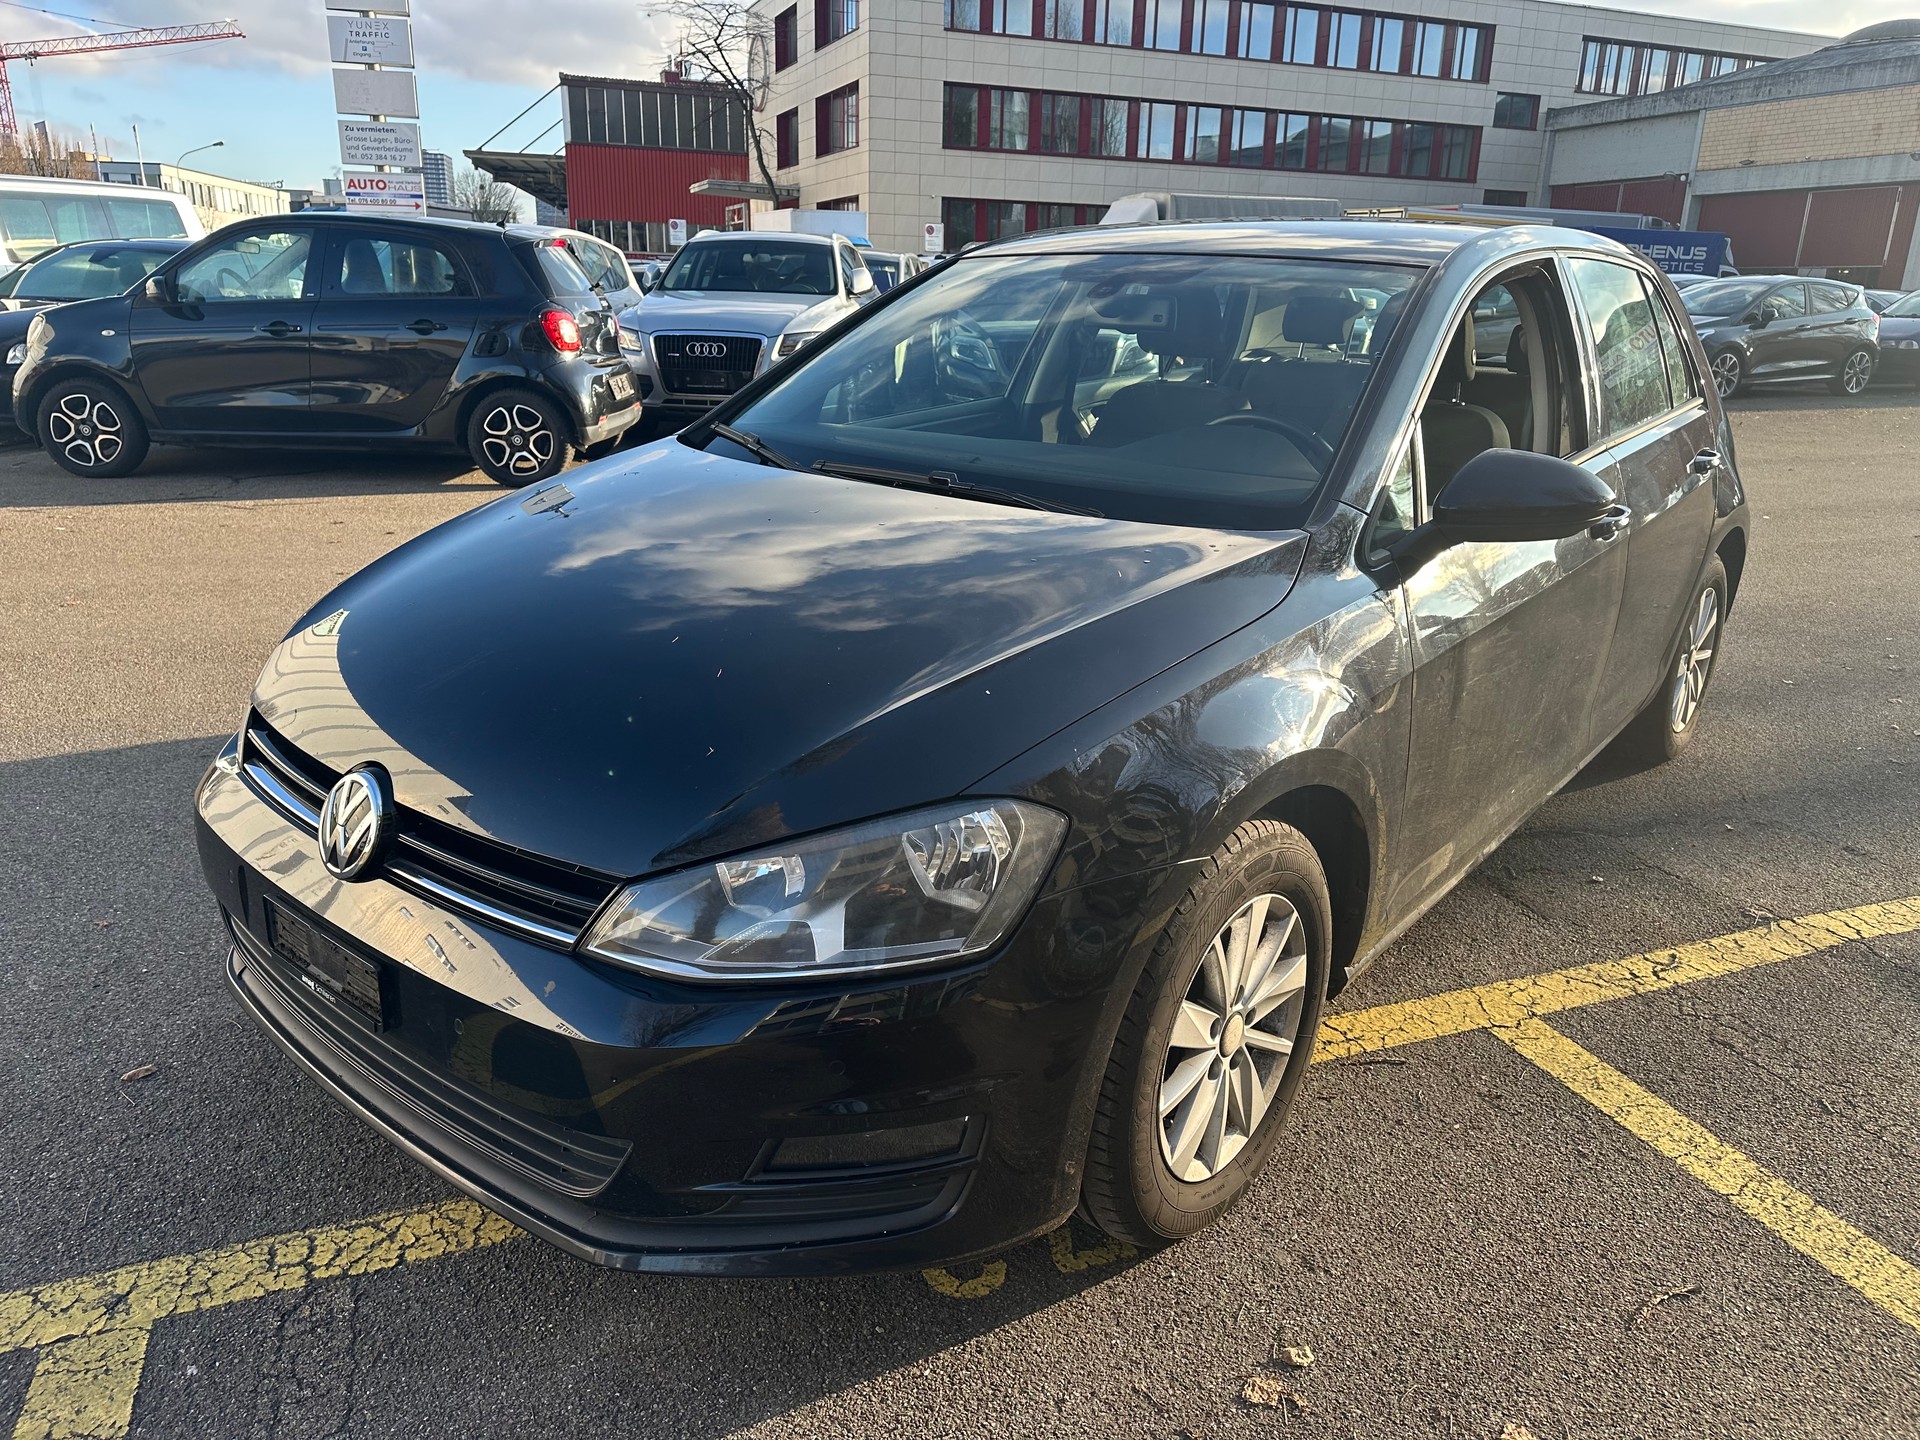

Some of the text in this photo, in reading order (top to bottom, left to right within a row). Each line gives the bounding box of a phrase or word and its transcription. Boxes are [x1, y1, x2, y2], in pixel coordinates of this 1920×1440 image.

[347, 20, 389, 30] YUNEX
[349, 30, 390, 38] TRAFFIC
[356, 126, 397, 134] vermieten:
[369, 136, 393, 144] Lager-,
[361, 145, 413, 153] Gewerberäume
[347, 178, 387, 191] AUTO
[1656, 261, 1705, 272] STICS
